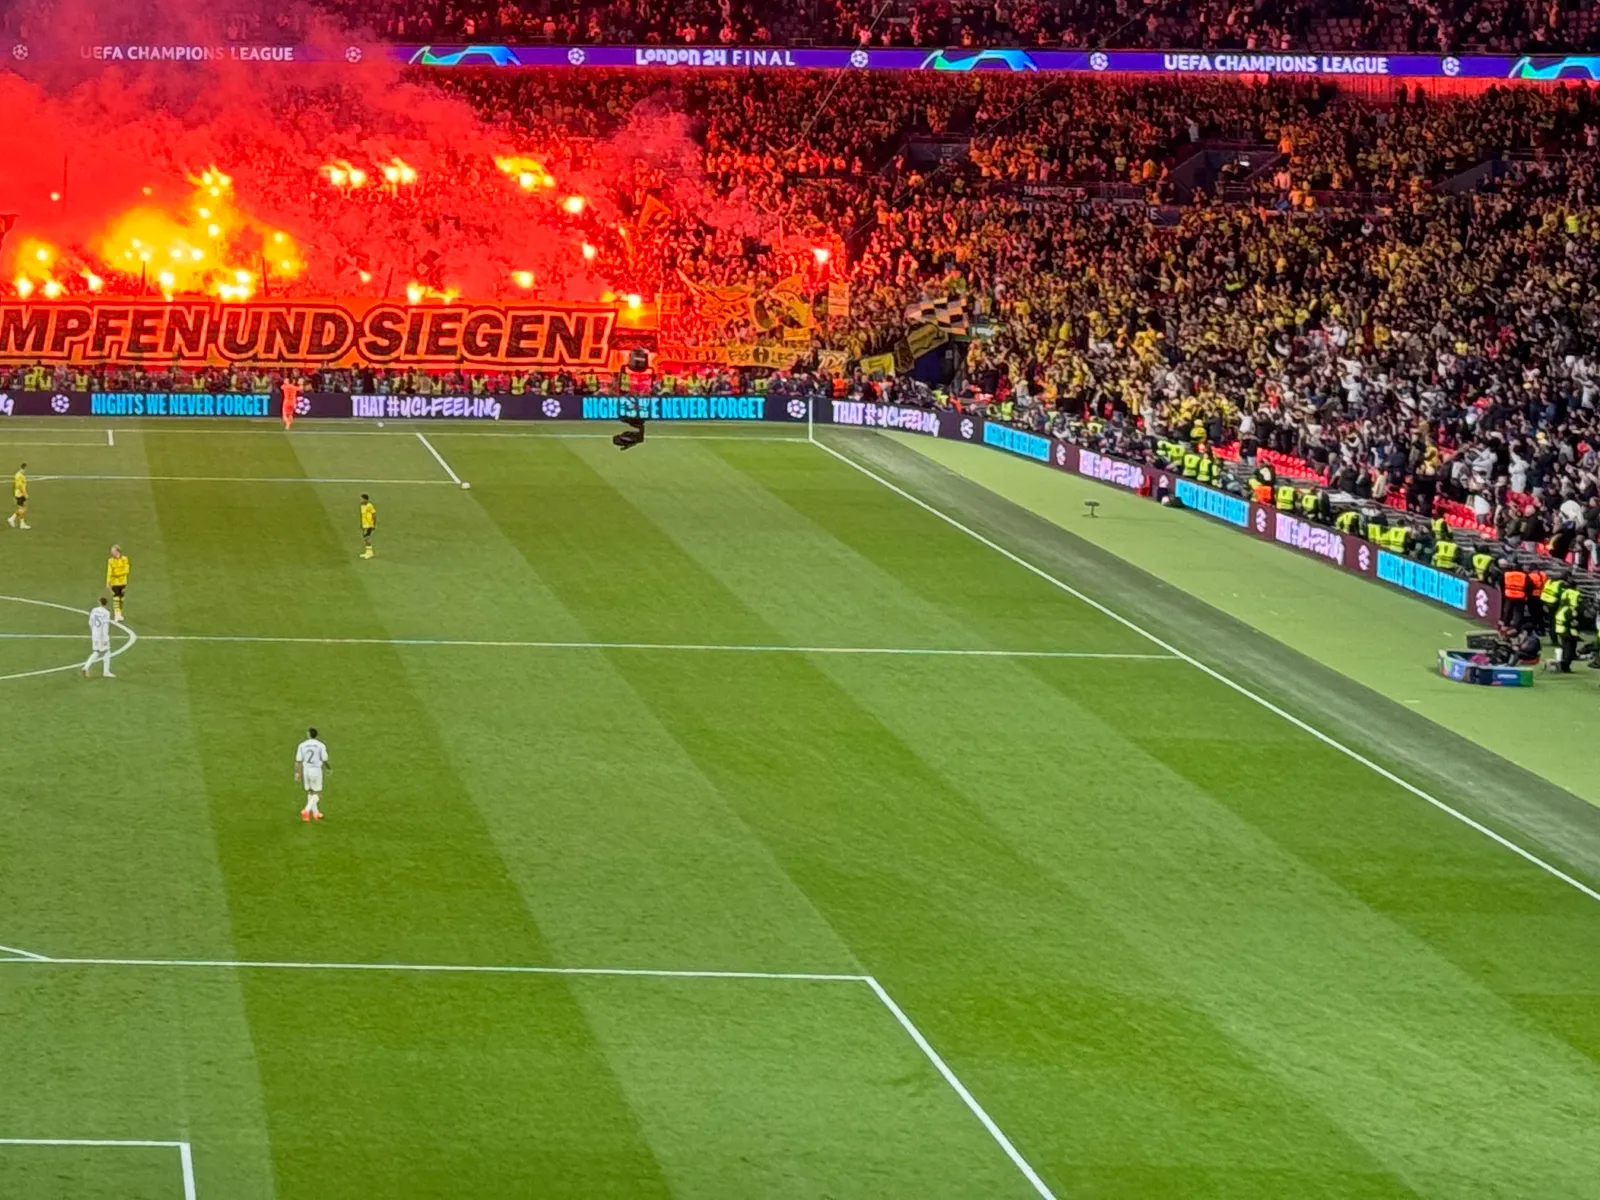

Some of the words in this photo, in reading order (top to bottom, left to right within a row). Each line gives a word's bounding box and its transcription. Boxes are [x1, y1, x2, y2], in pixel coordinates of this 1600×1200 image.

[80, 45, 123, 60] UEFA
[127, 45, 225, 61] CHAMPIONS
[230, 46, 294, 62] LEAGUE
[702, 48, 727, 66] 24
[732, 50, 796, 66] FINAL
[1164, 54, 1212, 71] UEFA
[1215, 54, 1318, 73] CHAMPIONS
[1322, 56, 1389, 75] LEAGUE
[219, 308, 353, 359] UND
[363, 310, 616, 362] SIEGEN!
[91, 393, 144, 415] NIGHTS
[146, 393, 167, 415] WE
[169, 393, 214, 415] NEVER
[216, 394, 270, 416] FORGET
[351, 395, 386, 417] THAT
[386, 396, 502, 421] #UCLFEELING
[661, 397, 709, 419] NEVER
[709, 397, 766, 419] FORGET
[831, 400, 866, 425] THAT
[306, 751, 315, 765] 2
